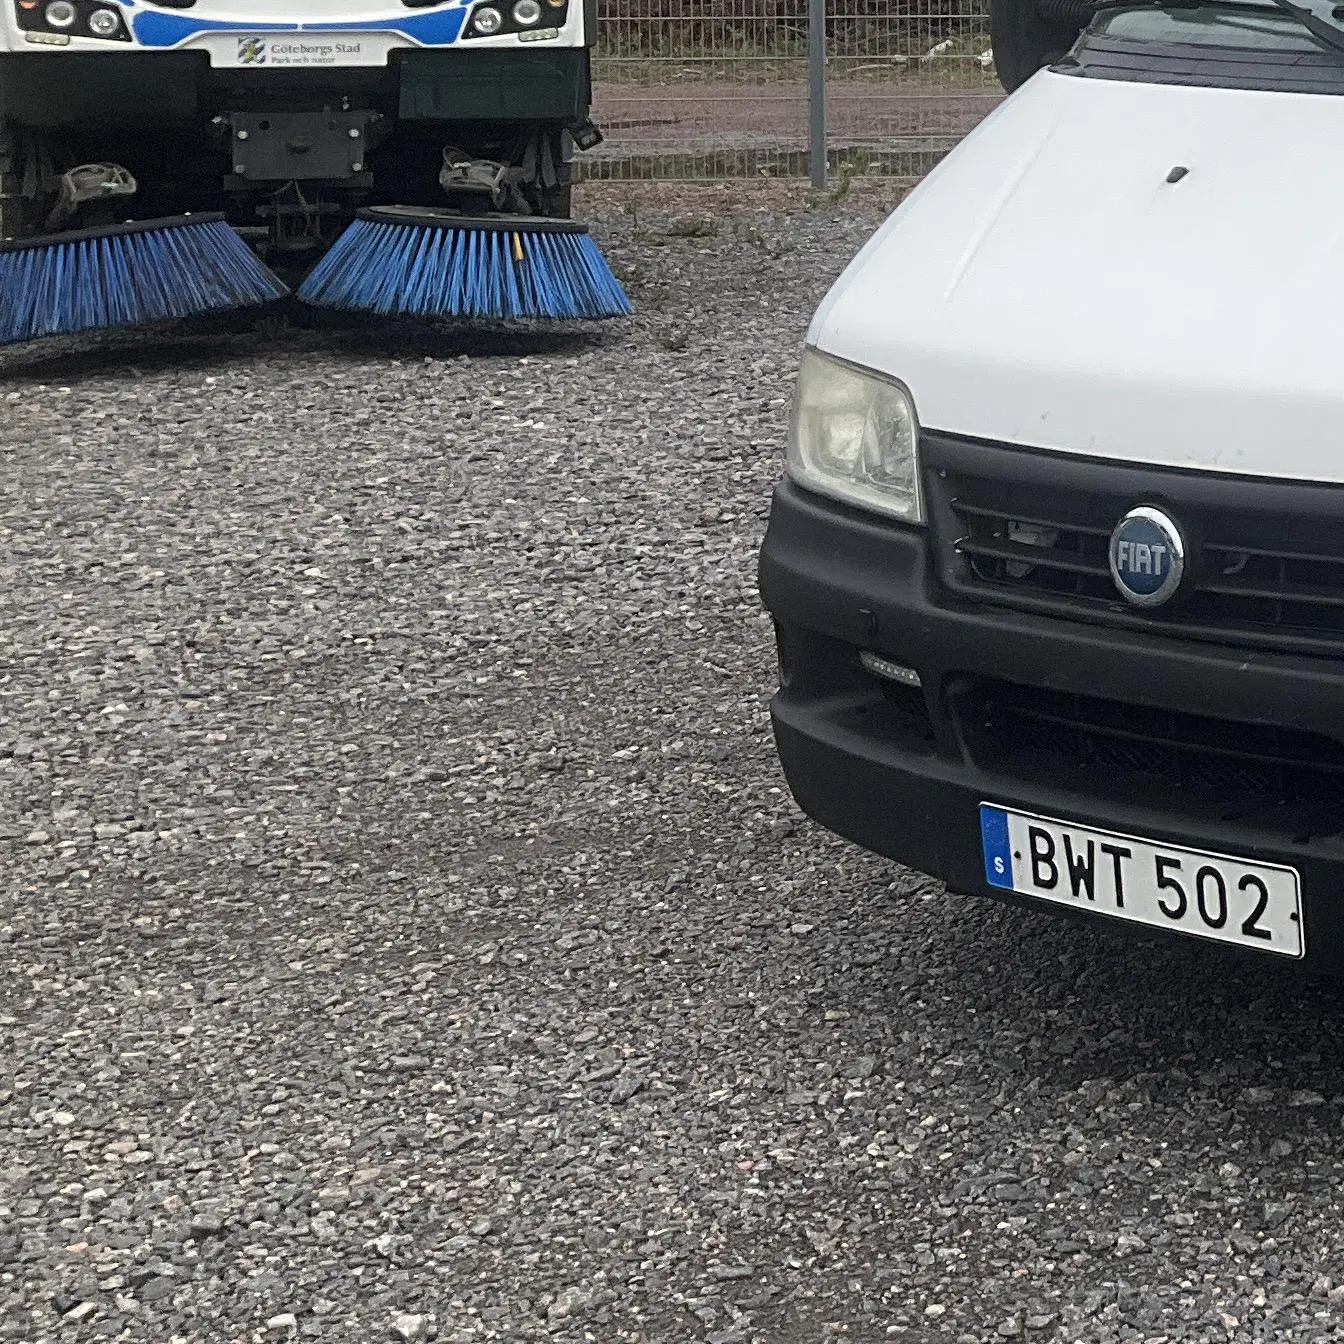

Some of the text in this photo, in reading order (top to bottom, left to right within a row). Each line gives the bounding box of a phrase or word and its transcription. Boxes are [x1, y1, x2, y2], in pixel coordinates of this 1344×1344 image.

[271, 43, 361, 56] Göteborgs Stad
[1117, 541, 1167, 576] FIAT
[994, 856, 1005, 874] S
[1028, 825, 1272, 941] BWT 502
